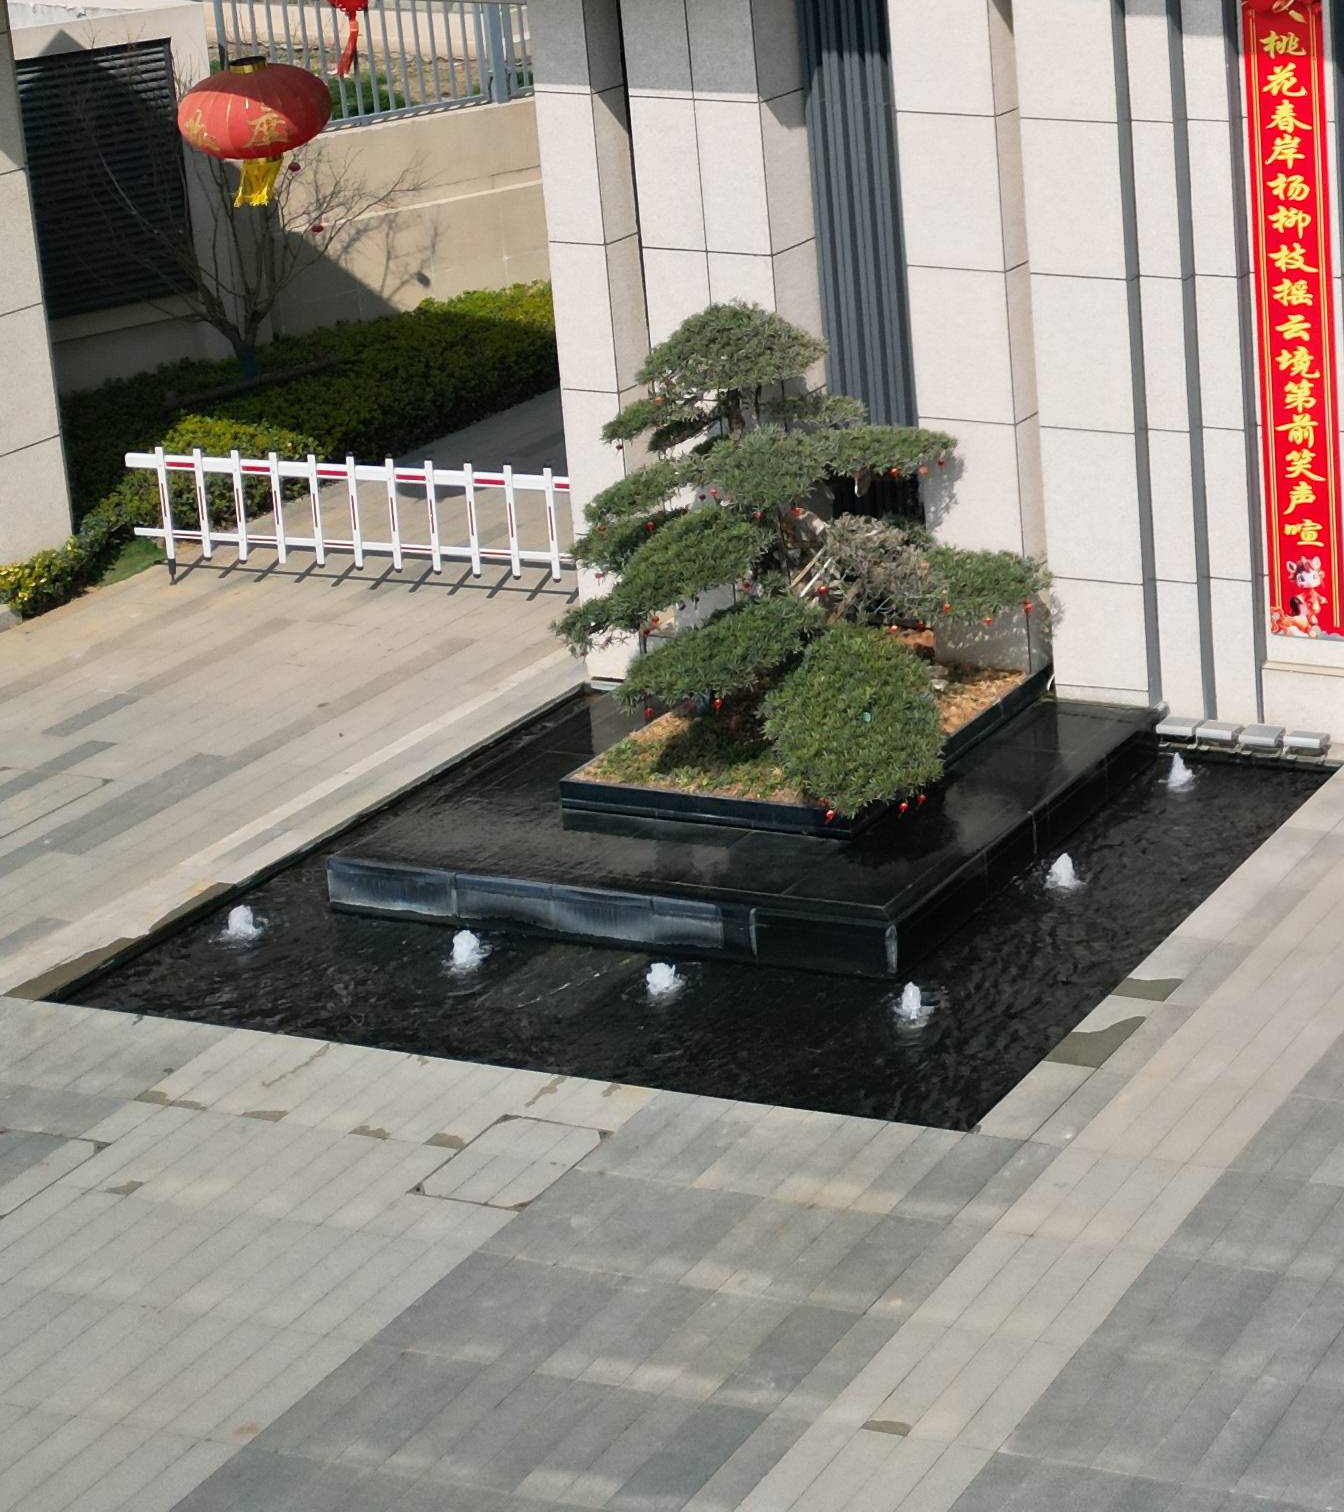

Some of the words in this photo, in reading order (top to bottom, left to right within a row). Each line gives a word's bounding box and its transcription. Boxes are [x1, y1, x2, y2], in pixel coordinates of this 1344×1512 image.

[1259, 29, 1327, 548] 桃花春岸杨柳枝摇云境第前笑声喧
